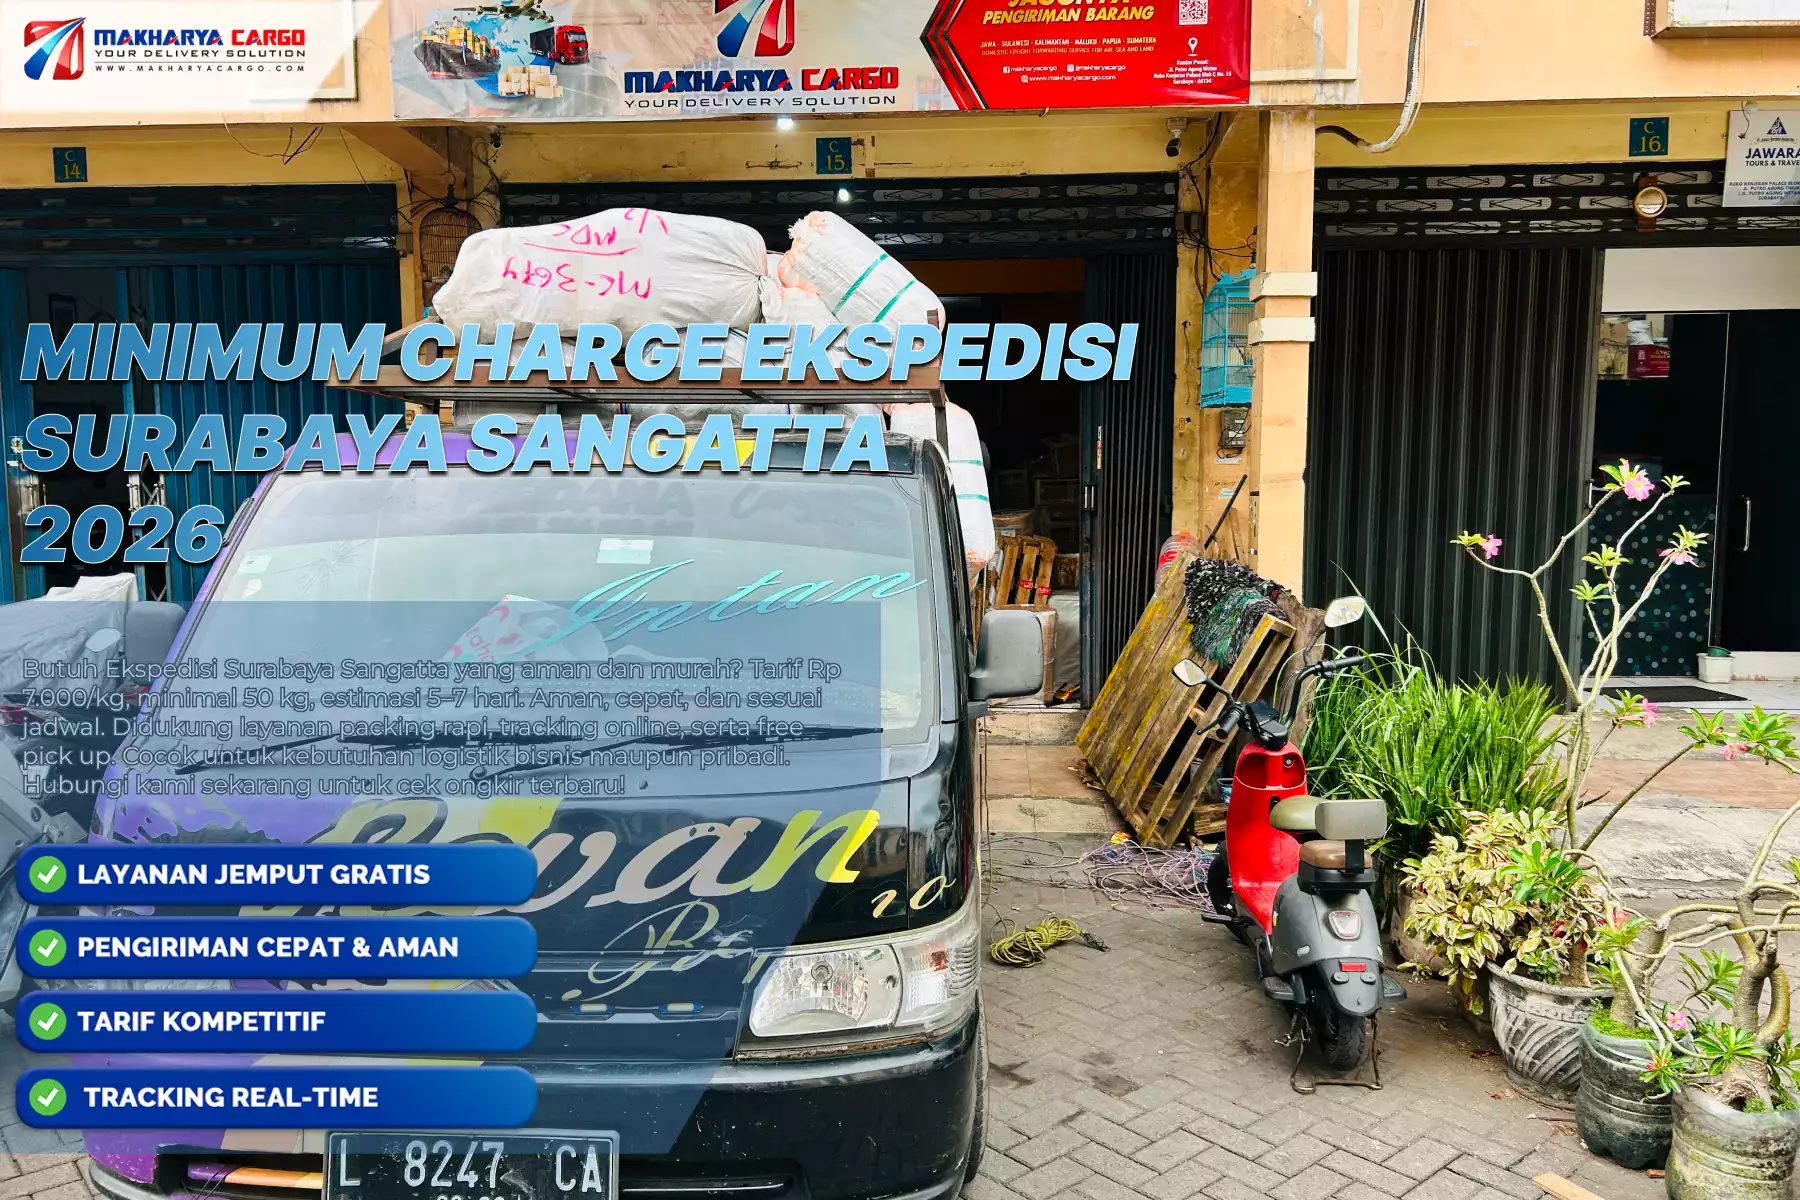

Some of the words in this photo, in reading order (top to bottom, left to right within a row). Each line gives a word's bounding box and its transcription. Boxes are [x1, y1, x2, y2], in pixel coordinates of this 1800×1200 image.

[982, 8, 1082, 24] PENGIRIMAN
[1085, 6, 1155, 21] BARANG
[1075, 64, 1126, 72] @makharyacargo
[624, 69, 793, 93] MAKHARYA
[801, 67, 899, 91] CARGO
[1029, 74, 1116, 82] www.makharyacargo.com
[625, 99, 679, 108] YOUR
[685, 98, 785, 108] DELIVERY
[792, 96, 896, 106] SOLUTION
[1644, 121, 1655, 133] C
[828, 141, 839, 153] C
[1640, 136, 1661, 152] 16
[65, 150, 75, 161] C
[1745, 148, 1800, 159] JAWARA
[825, 155, 845, 170] 15
[63, 163, 81, 179] 14
[339, 1138, 361, 1188] L
[403, 1140, 505, 1190] 8247
[555, 1144, 603, 1193] CA
